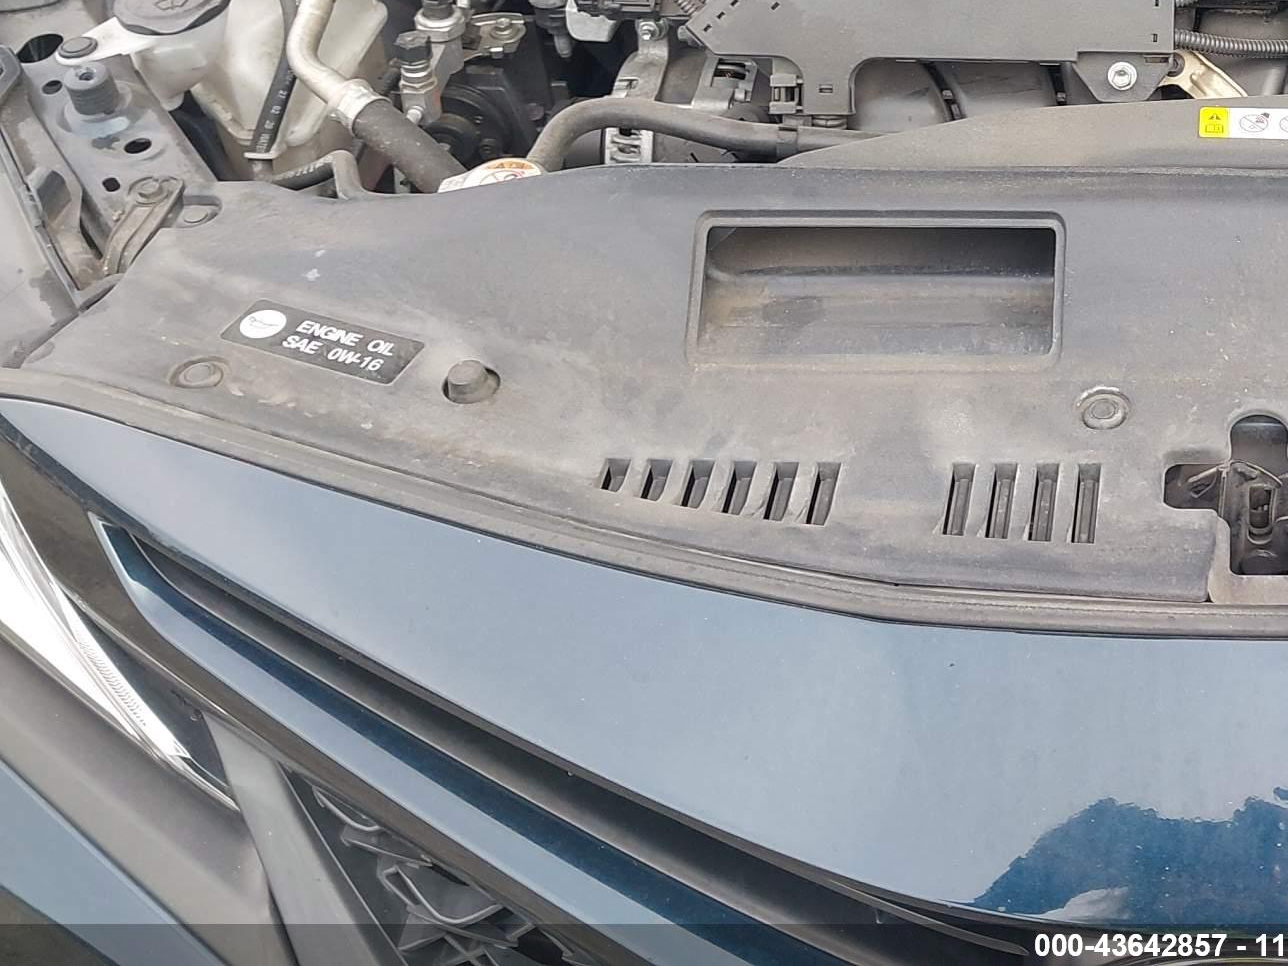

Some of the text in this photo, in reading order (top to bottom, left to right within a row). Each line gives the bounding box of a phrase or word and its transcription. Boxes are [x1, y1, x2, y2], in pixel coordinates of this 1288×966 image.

[282, 335, 385, 371] SAE 0W-16
[296, 320, 395, 357] ENGINE OIL
